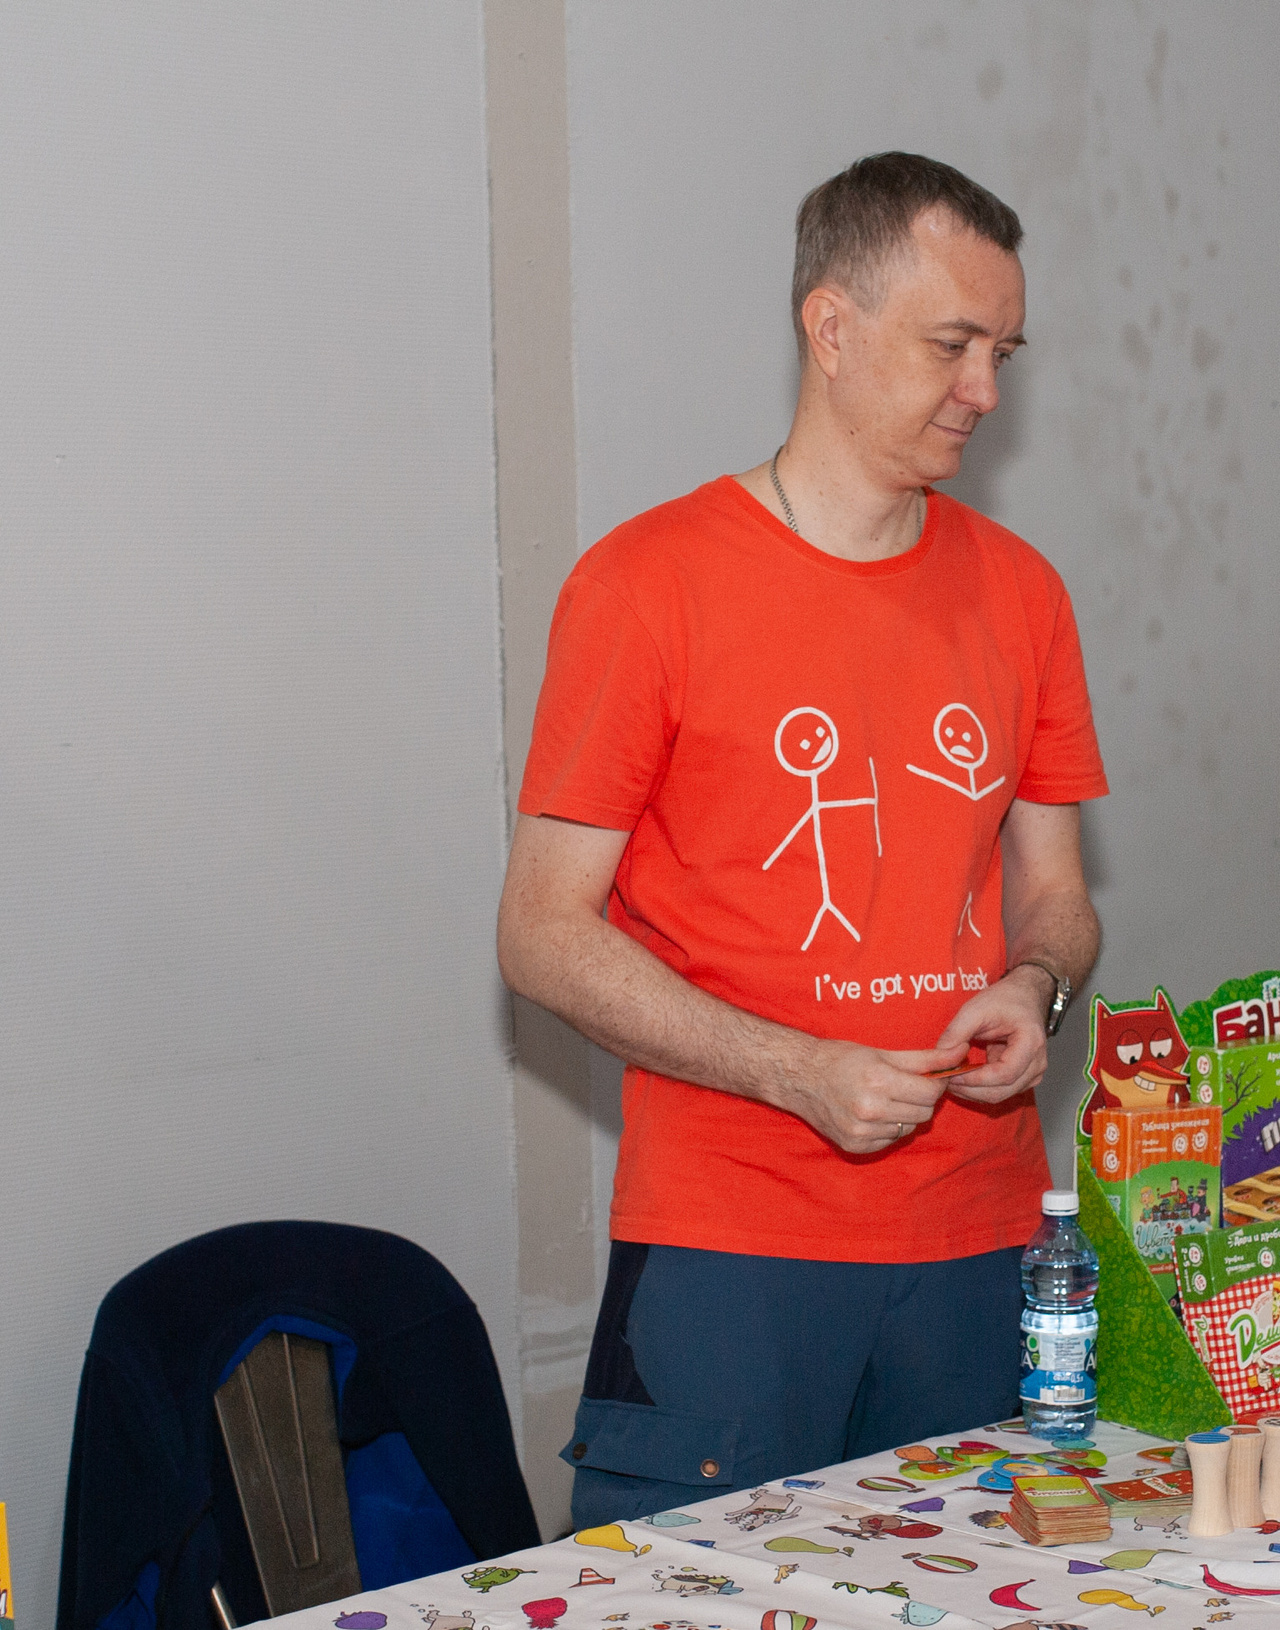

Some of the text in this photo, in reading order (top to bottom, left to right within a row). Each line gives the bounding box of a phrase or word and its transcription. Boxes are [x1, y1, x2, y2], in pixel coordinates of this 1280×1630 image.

[815, 967, 988, 1003] I've got your back
